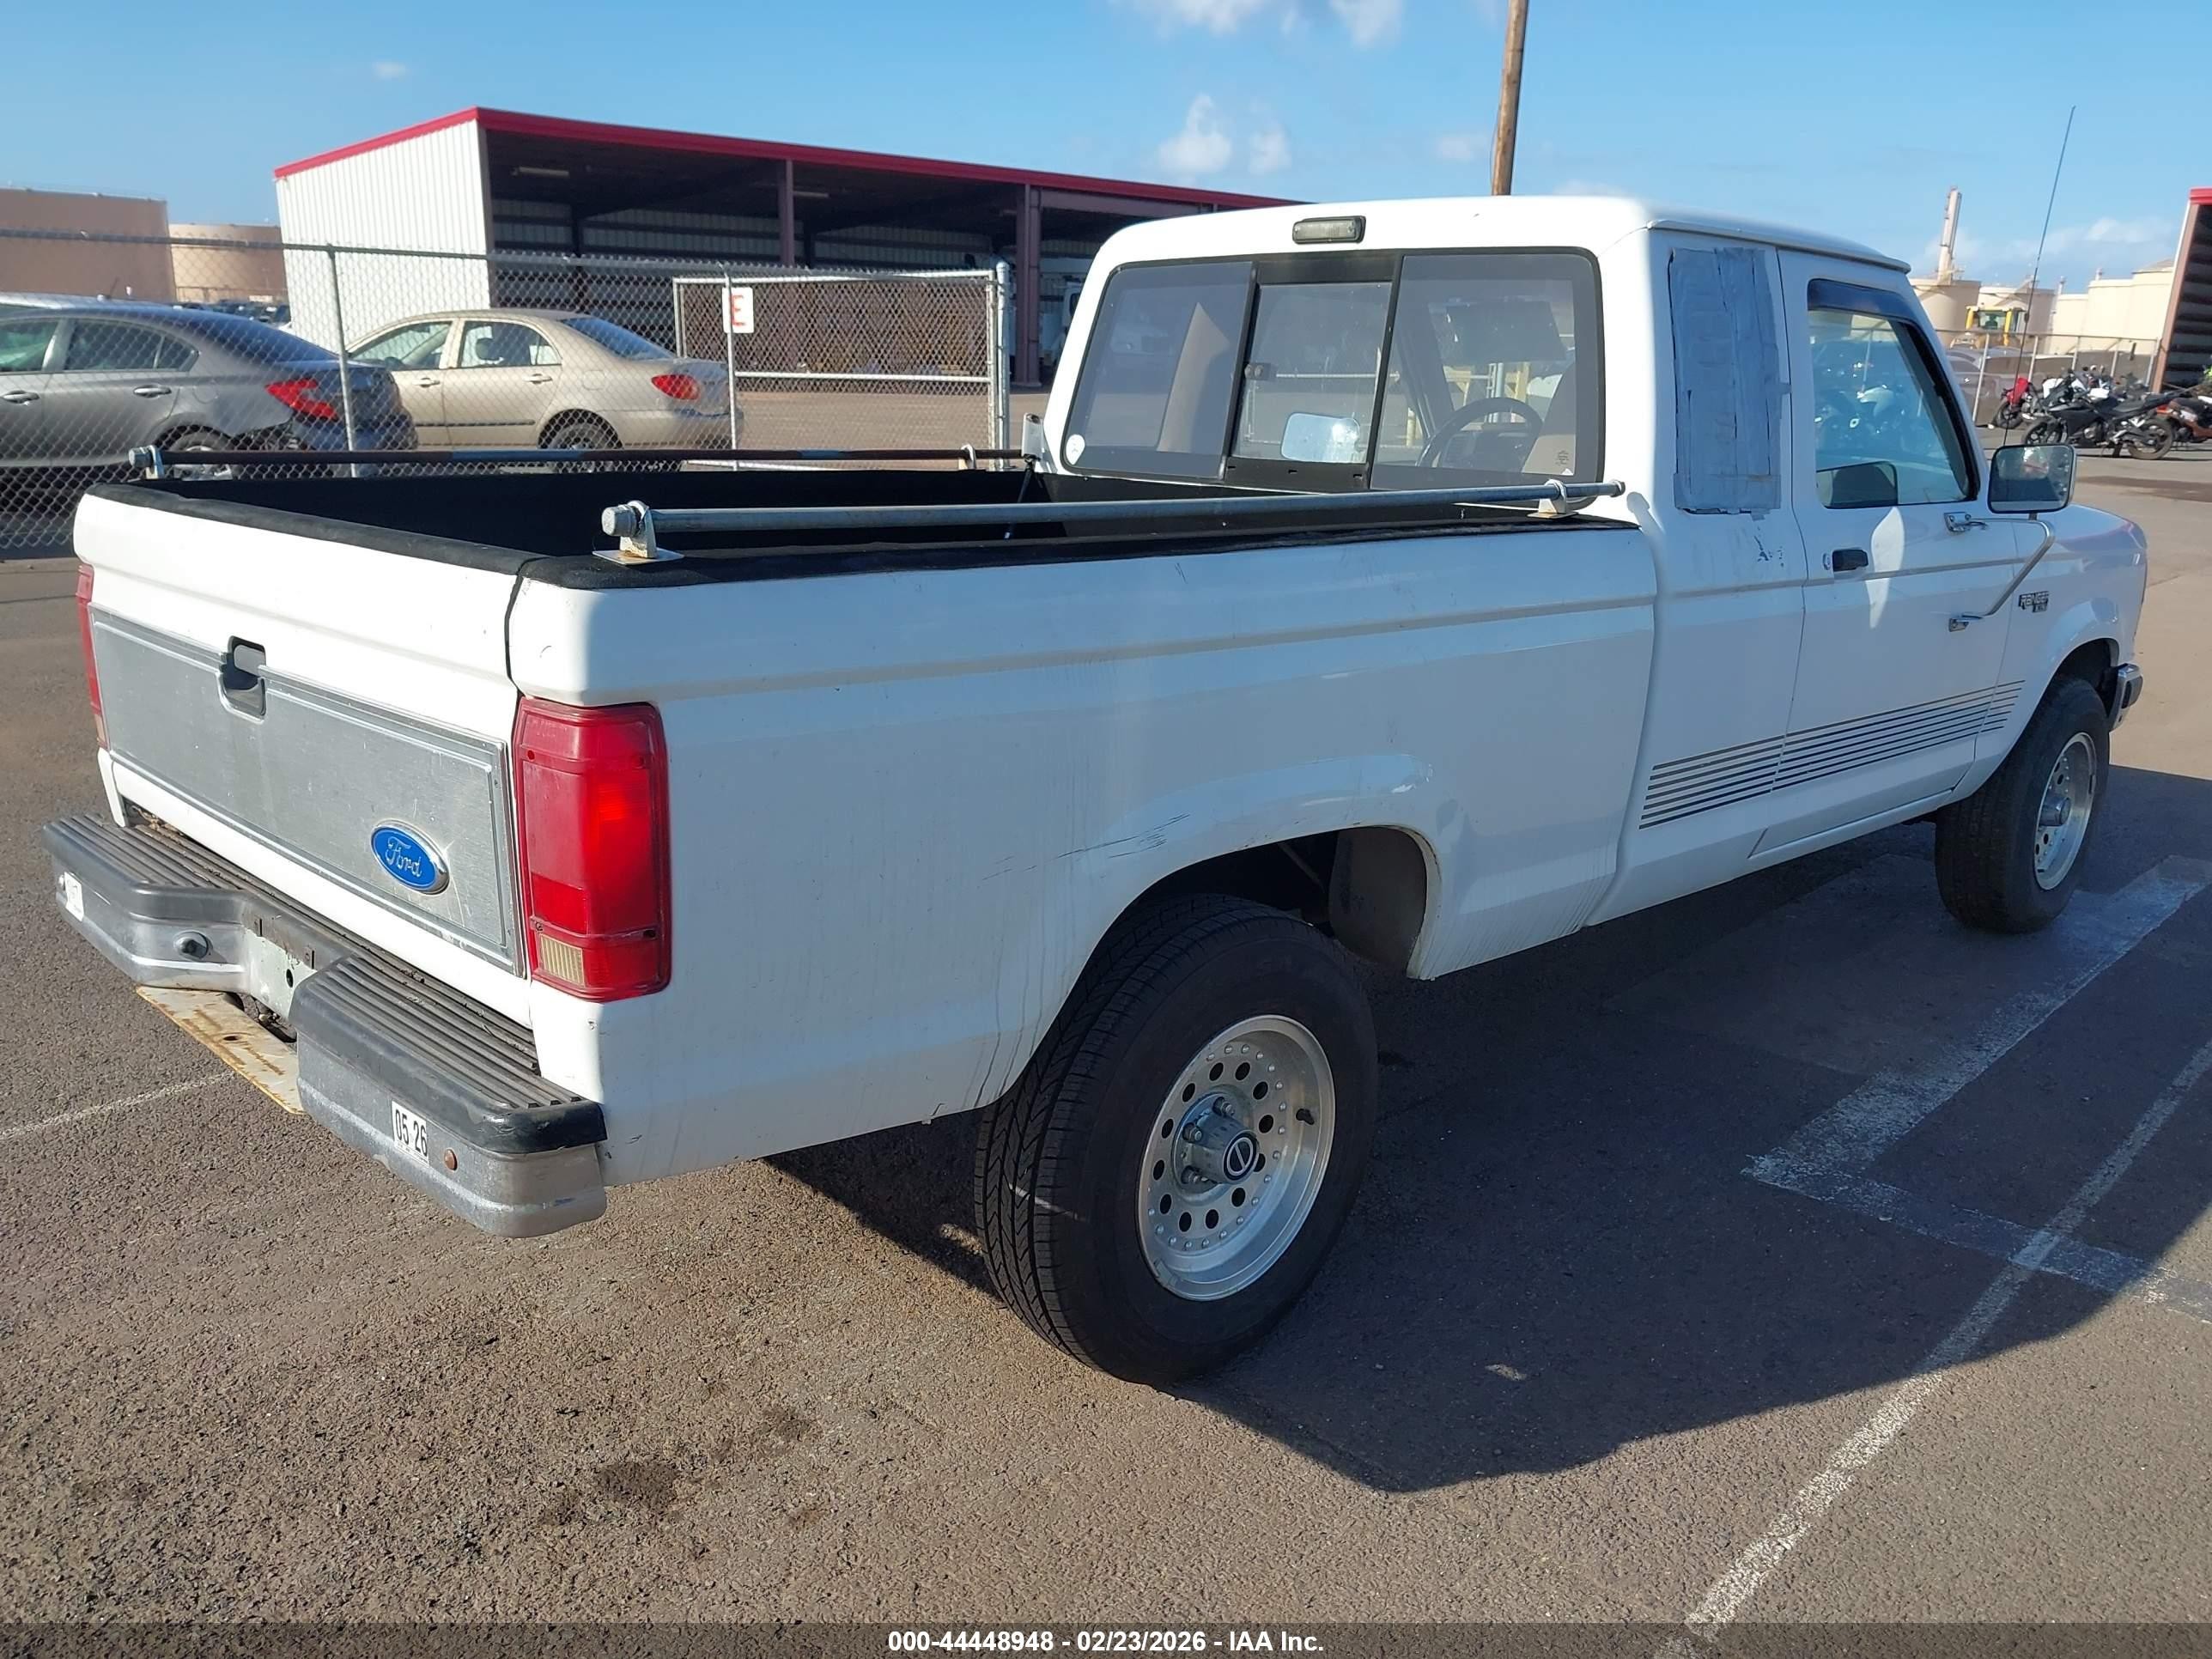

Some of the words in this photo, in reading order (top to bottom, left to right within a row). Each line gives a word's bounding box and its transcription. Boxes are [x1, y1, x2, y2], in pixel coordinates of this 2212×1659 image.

[728, 294, 746, 326] E
[2019, 591, 2050, 609] RANGE
[385, 836, 422, 878] Ford
[395, 1109, 410, 1145] 05
[413, 1121, 428, 1157] 26
